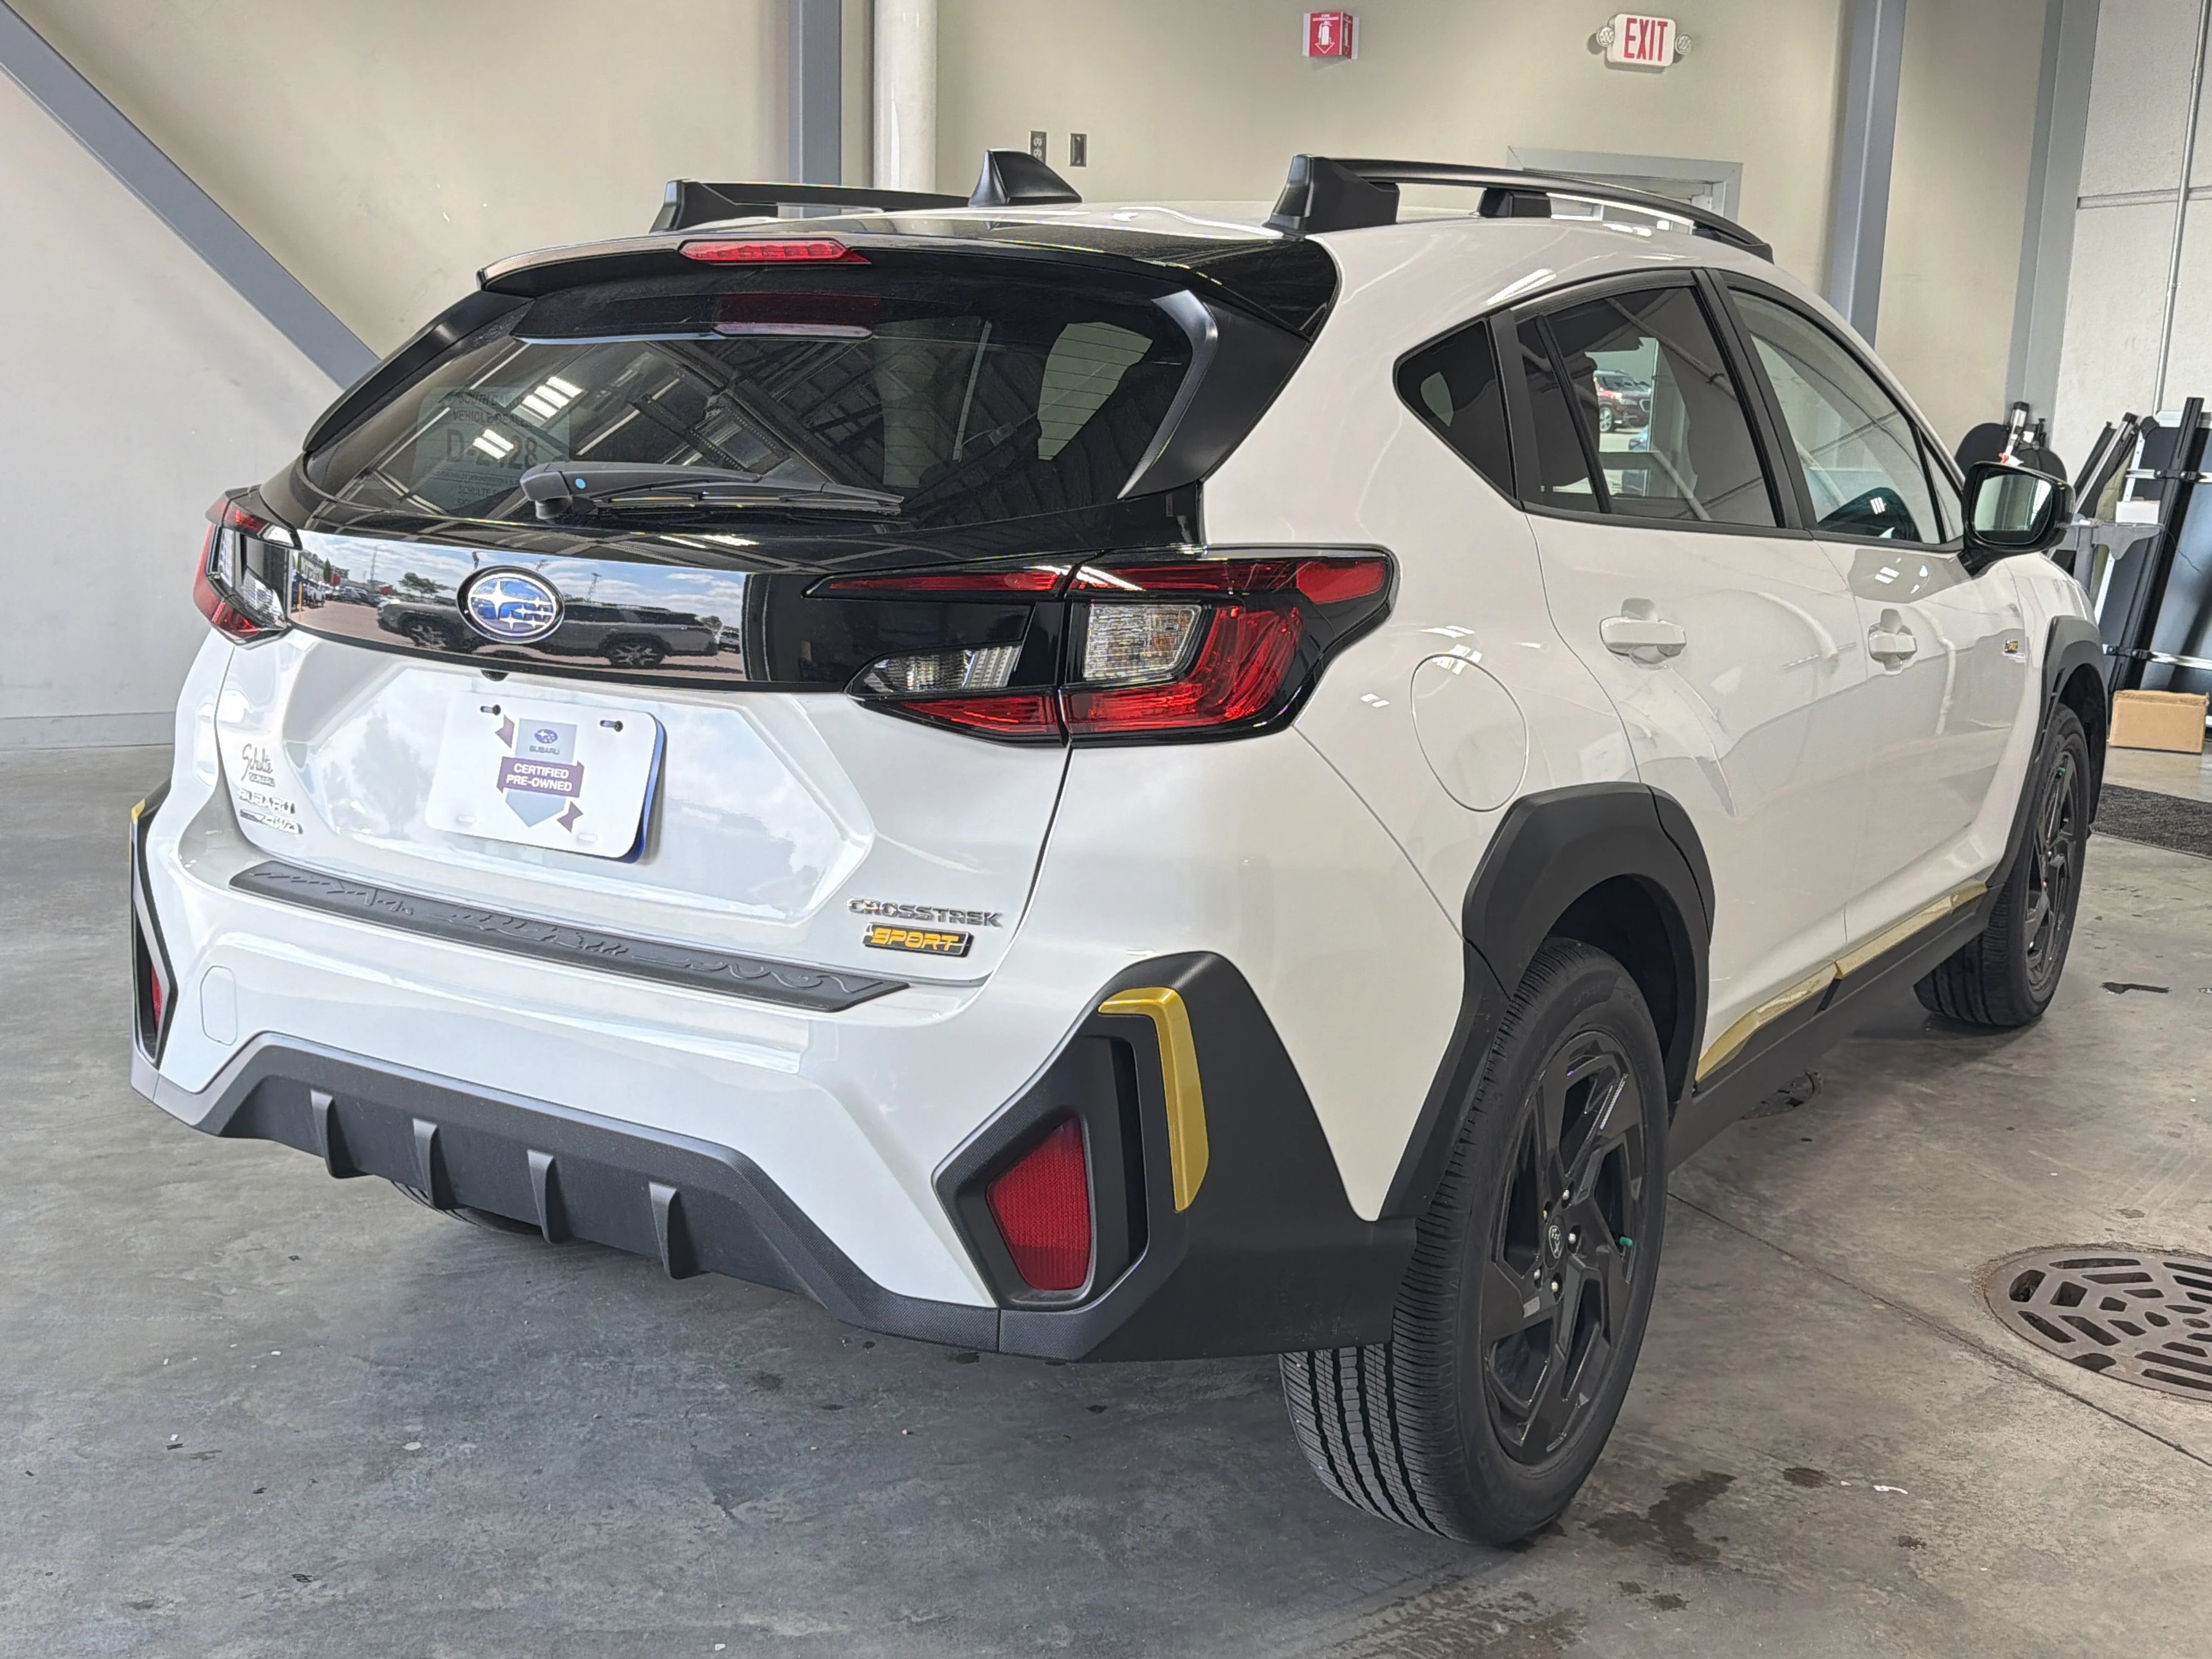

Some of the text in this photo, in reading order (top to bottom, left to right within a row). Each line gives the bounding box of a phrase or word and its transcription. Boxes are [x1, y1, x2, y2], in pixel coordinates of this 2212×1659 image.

[1624, 18, 1668, 62] EXIT
[452, 409, 493, 424] VEHICLE
[458, 485, 491, 496] SCHULTE
[529, 745, 560, 755] SUBARU
[514, 763, 569, 779] CERTIFIED
[506, 774, 572, 792] PRE-OWNED
[237, 788, 295, 815] SUBARU
[847, 898, 1003, 927] CROSSTREK
[870, 928, 962, 951] SPORT
